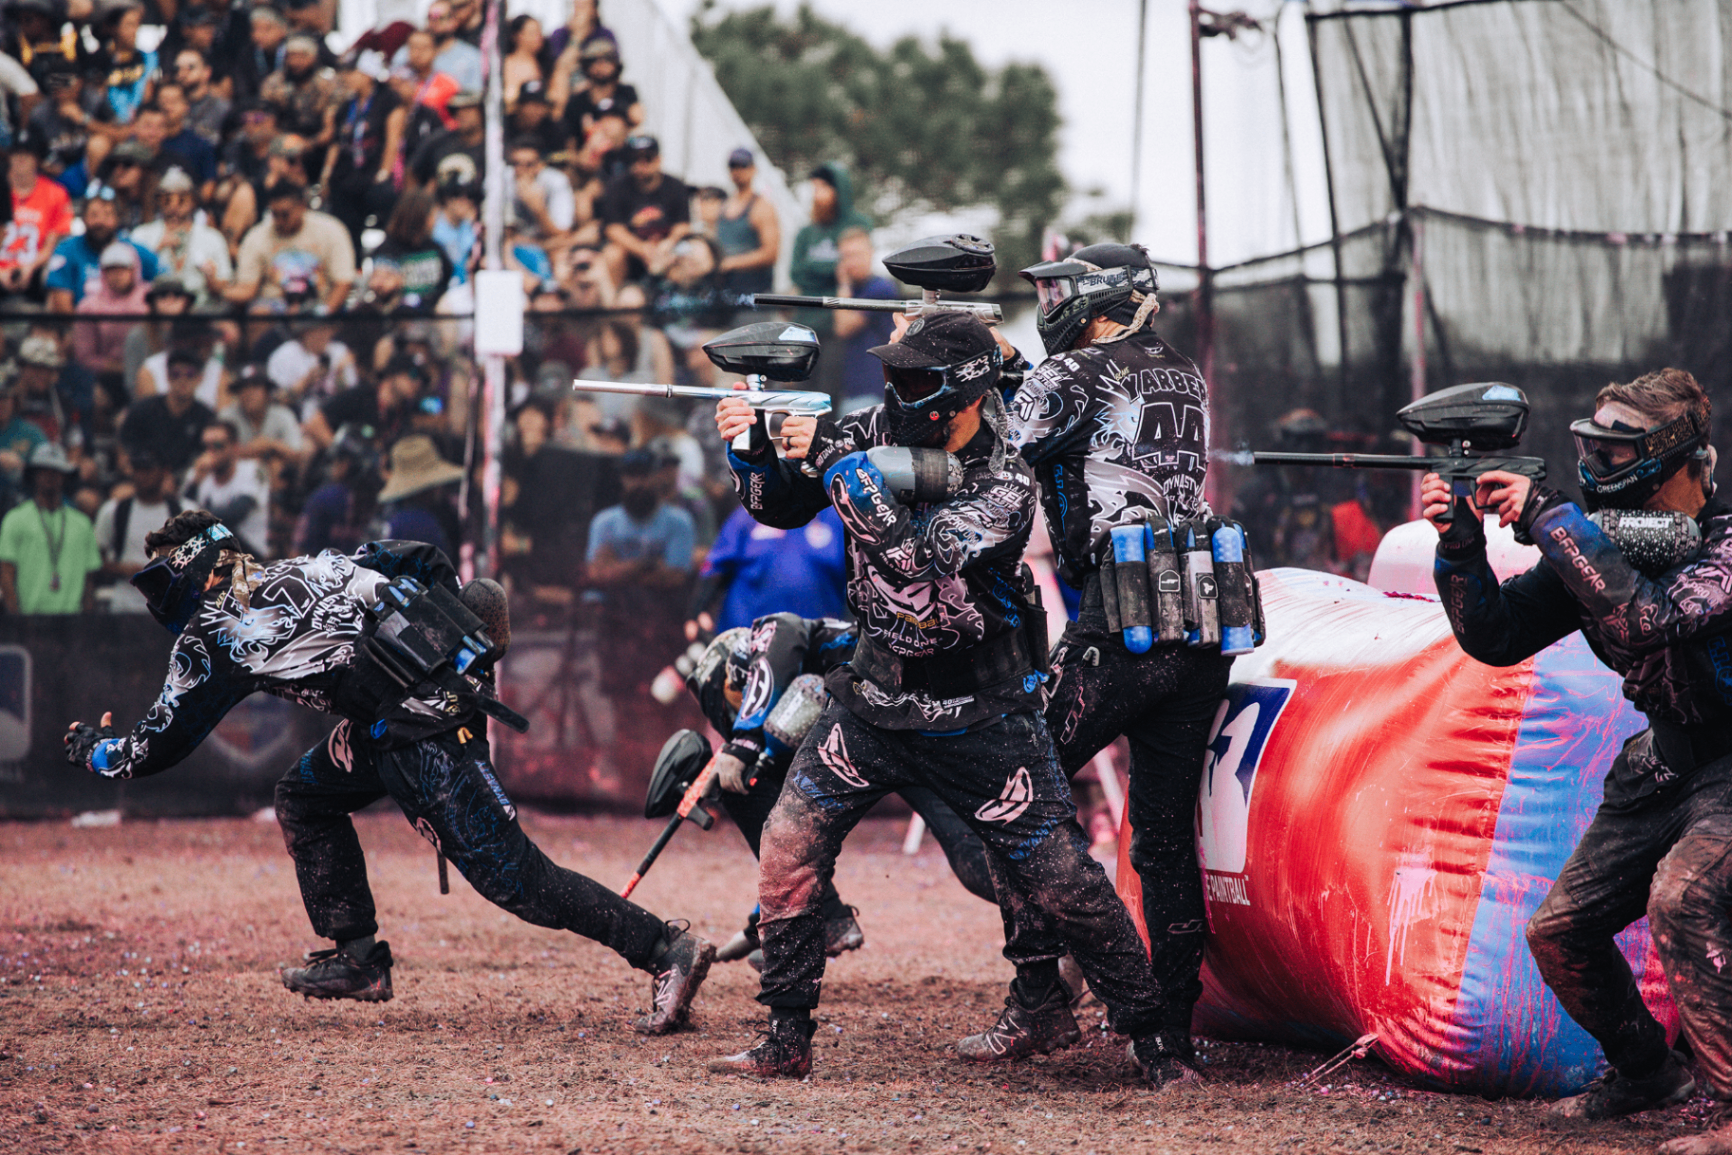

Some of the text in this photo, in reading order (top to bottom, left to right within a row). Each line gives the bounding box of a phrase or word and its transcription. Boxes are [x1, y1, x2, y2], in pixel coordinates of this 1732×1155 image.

[1596, 474, 1639, 493] GREENSPAN
[1618, 516, 1675, 529] PROJECT
[1210, 874, 1251, 907] PAINTBALL
